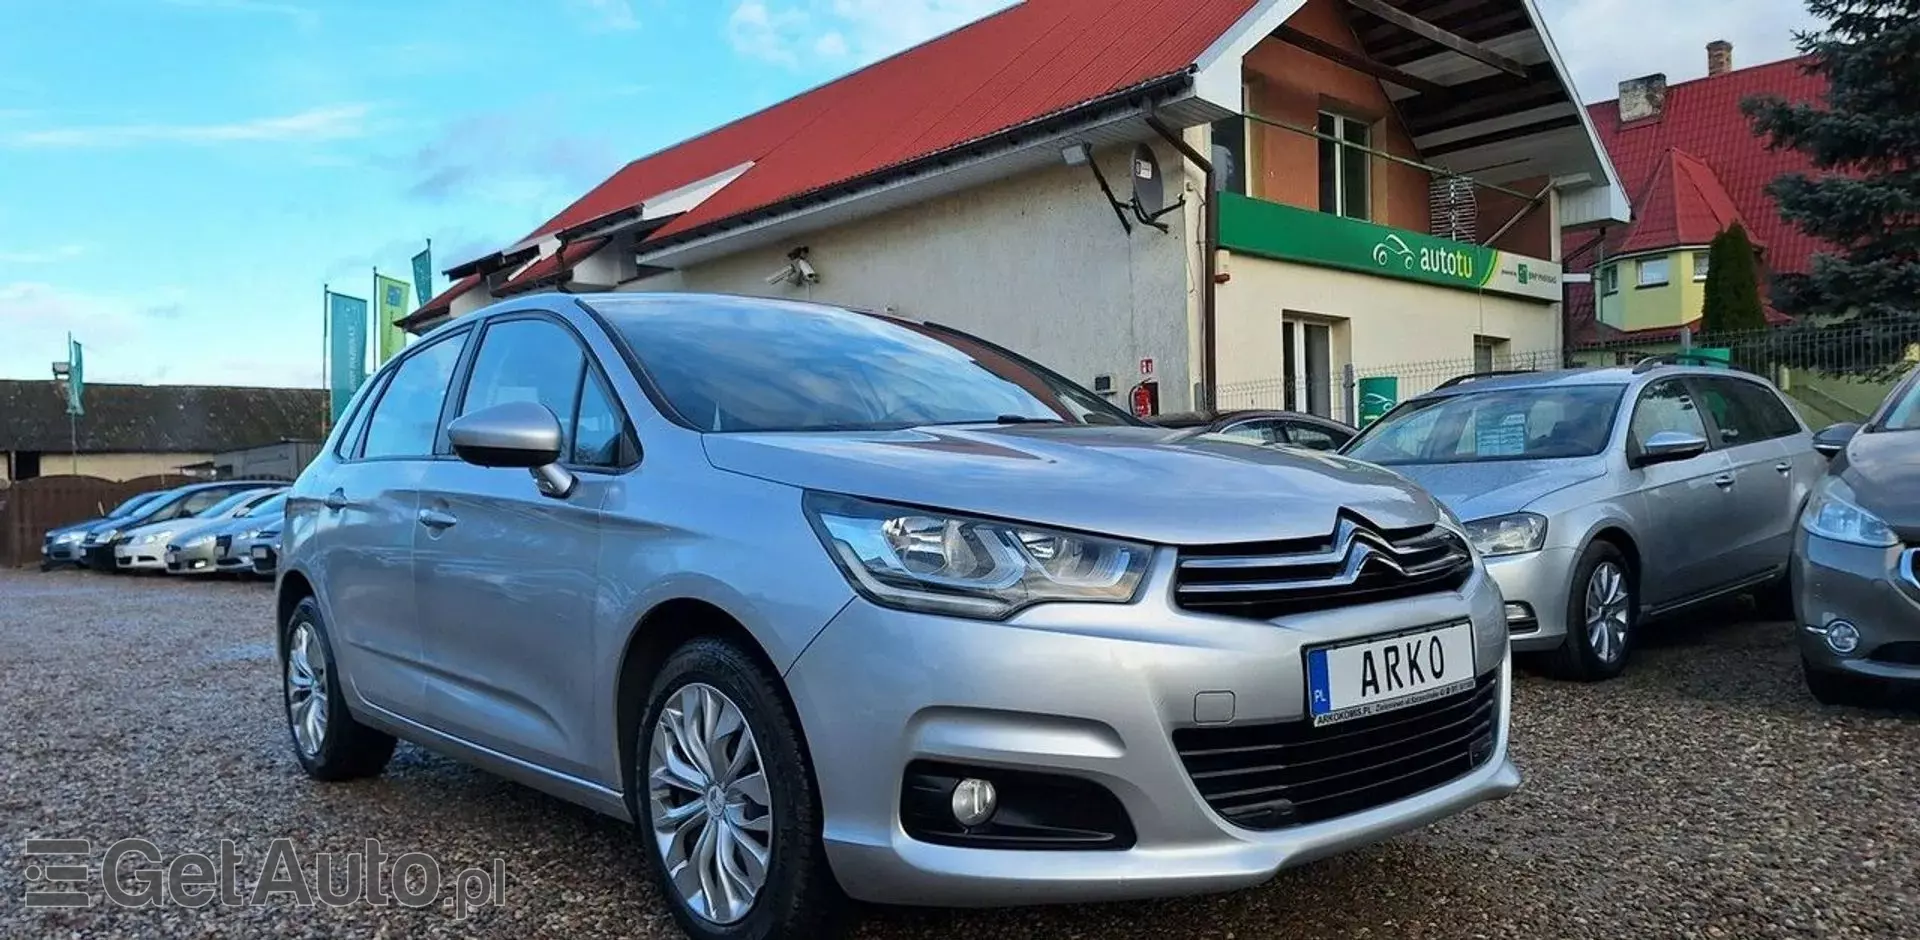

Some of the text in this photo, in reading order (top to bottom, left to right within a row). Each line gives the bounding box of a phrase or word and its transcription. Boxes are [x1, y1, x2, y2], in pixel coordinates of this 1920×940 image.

[1420, 246, 1473, 279] autotu
[1361, 635, 1445, 698] ARKO
[1313, 688, 1327, 703] PL
